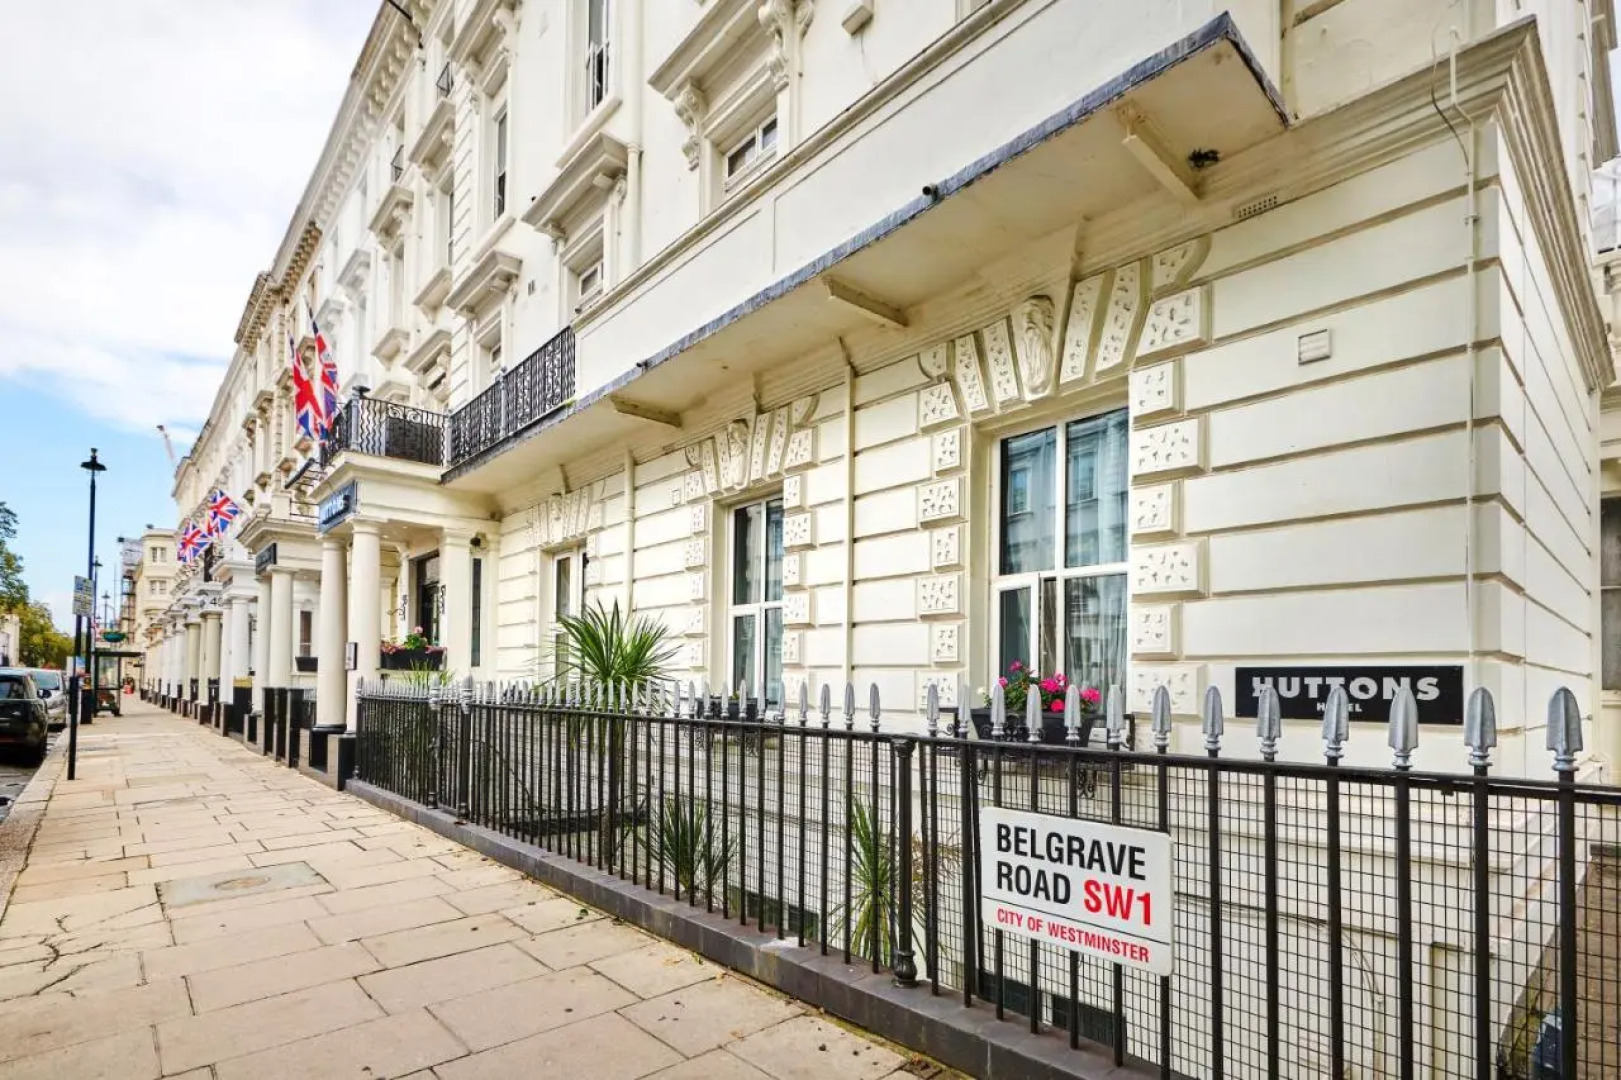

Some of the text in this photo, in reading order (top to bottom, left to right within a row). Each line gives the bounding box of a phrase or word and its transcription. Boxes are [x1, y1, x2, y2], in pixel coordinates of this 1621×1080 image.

[1252, 676, 1440, 701] HUTTONS
[1316, 701, 1362, 712] HEL
[997, 823, 1146, 881] BELGRAVE
[997, 860, 1151, 926] ROAD SW1
[997, 908, 1149, 963] CITY OF WESTMINSTER
